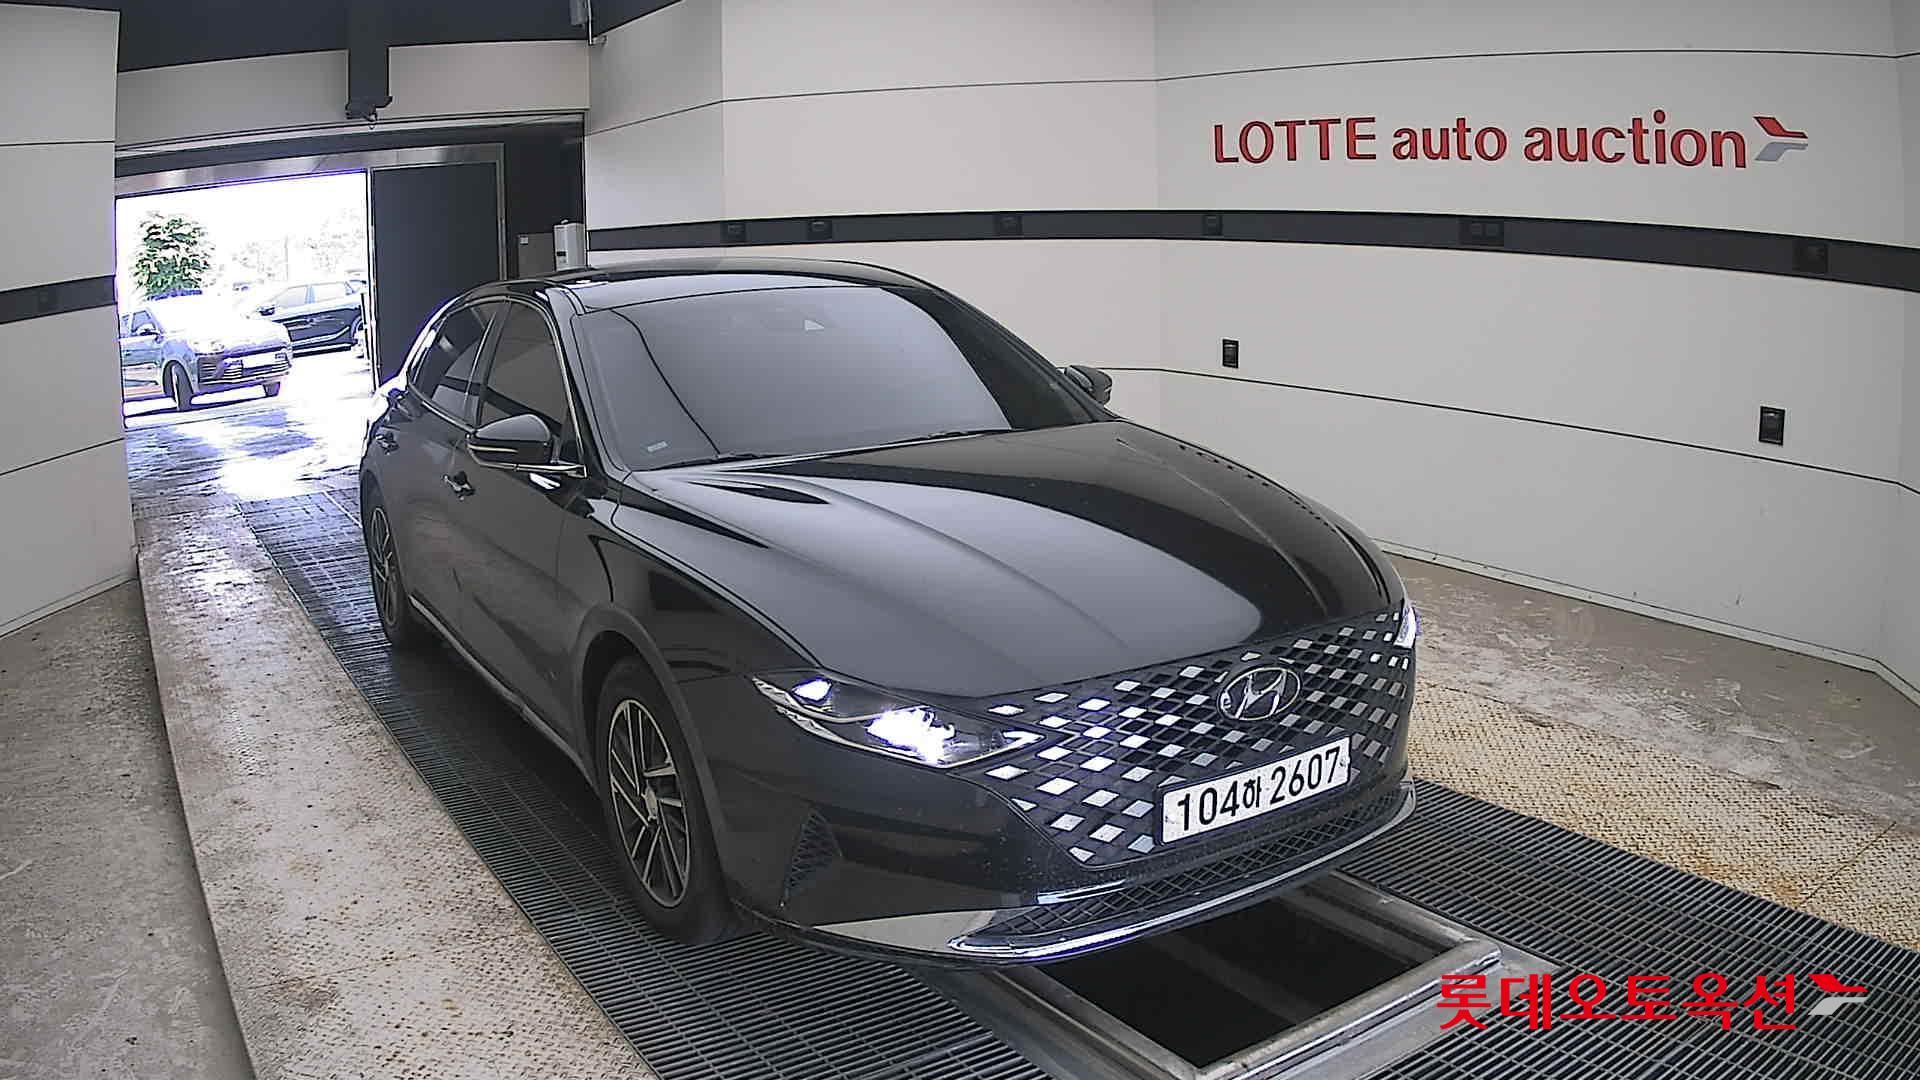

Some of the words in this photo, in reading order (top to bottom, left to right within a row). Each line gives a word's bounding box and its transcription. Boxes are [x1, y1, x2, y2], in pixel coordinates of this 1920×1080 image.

[1213, 116, 1377, 164] LOTTE
[1392, 116, 1508, 161] auto
[1523, 109, 1747, 169] auction
[1177, 776, 1262, 832] 104하
[1270, 746, 1341, 805] 2607
